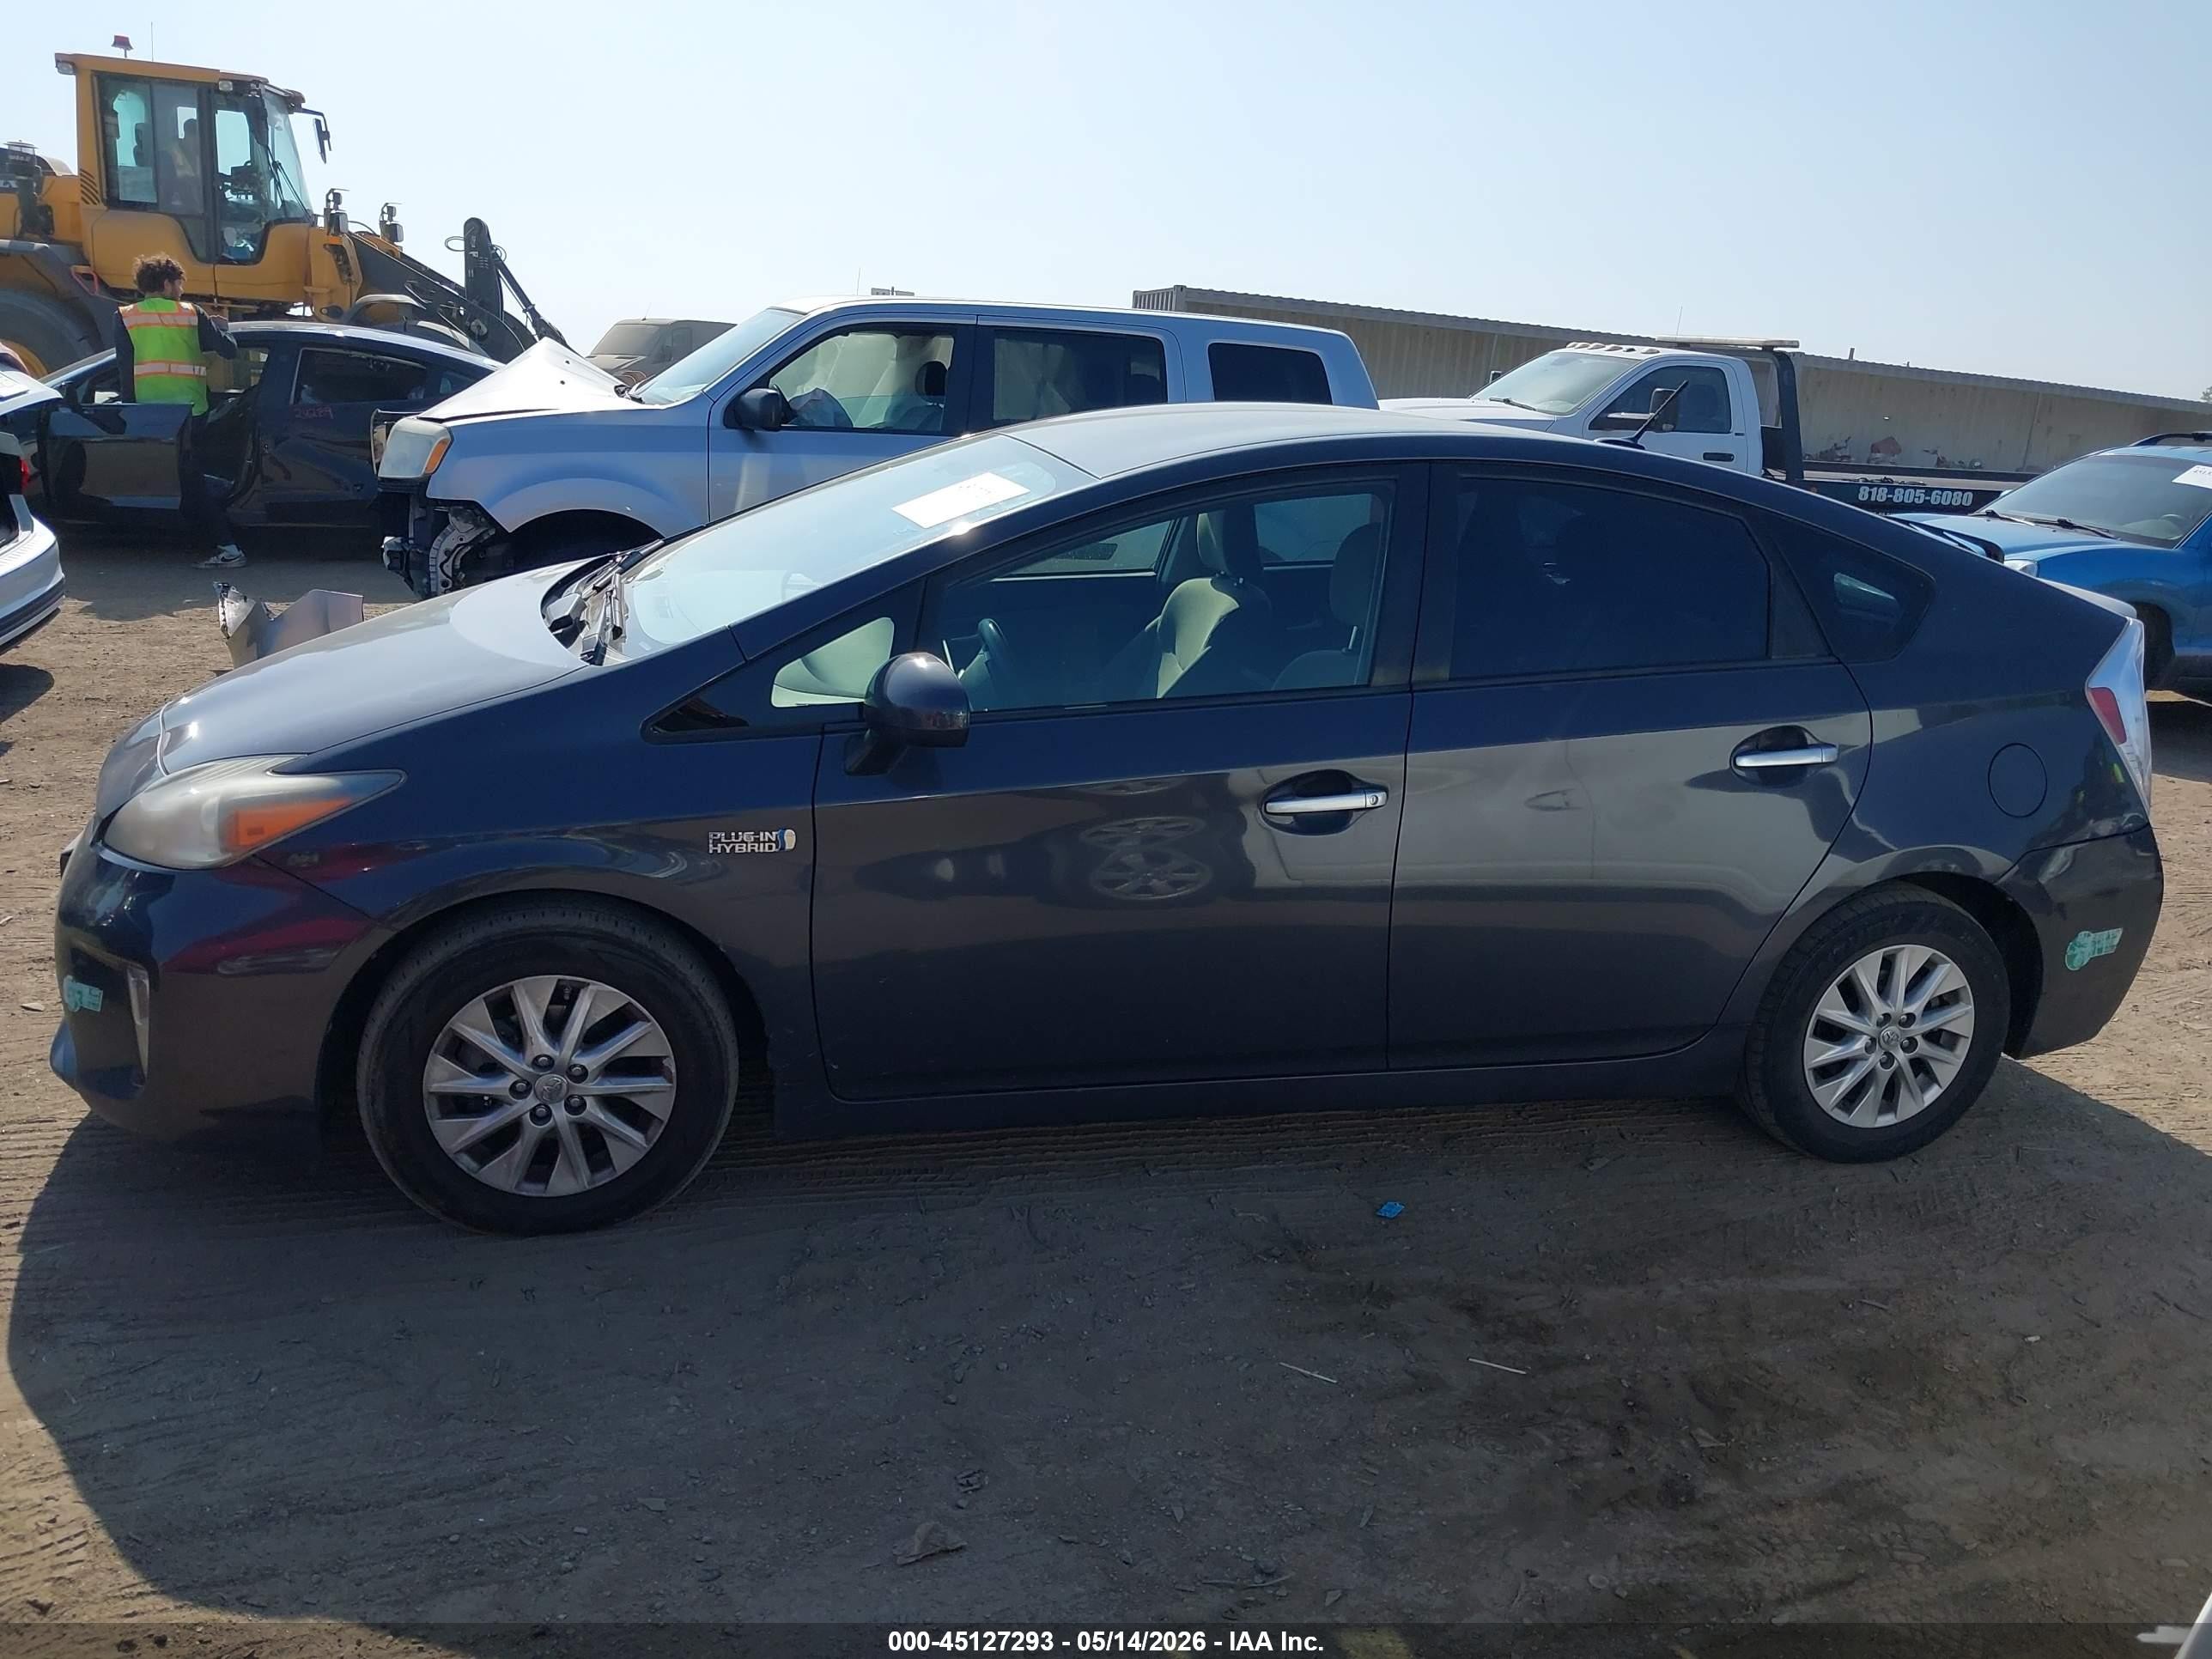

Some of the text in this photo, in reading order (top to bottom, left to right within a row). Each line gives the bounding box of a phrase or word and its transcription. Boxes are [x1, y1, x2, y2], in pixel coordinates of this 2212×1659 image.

[1857, 485, 1973, 507] 818-805-6080
[708, 831, 776, 842] PLUG-IN
[708, 842, 776, 854] HYBRID
